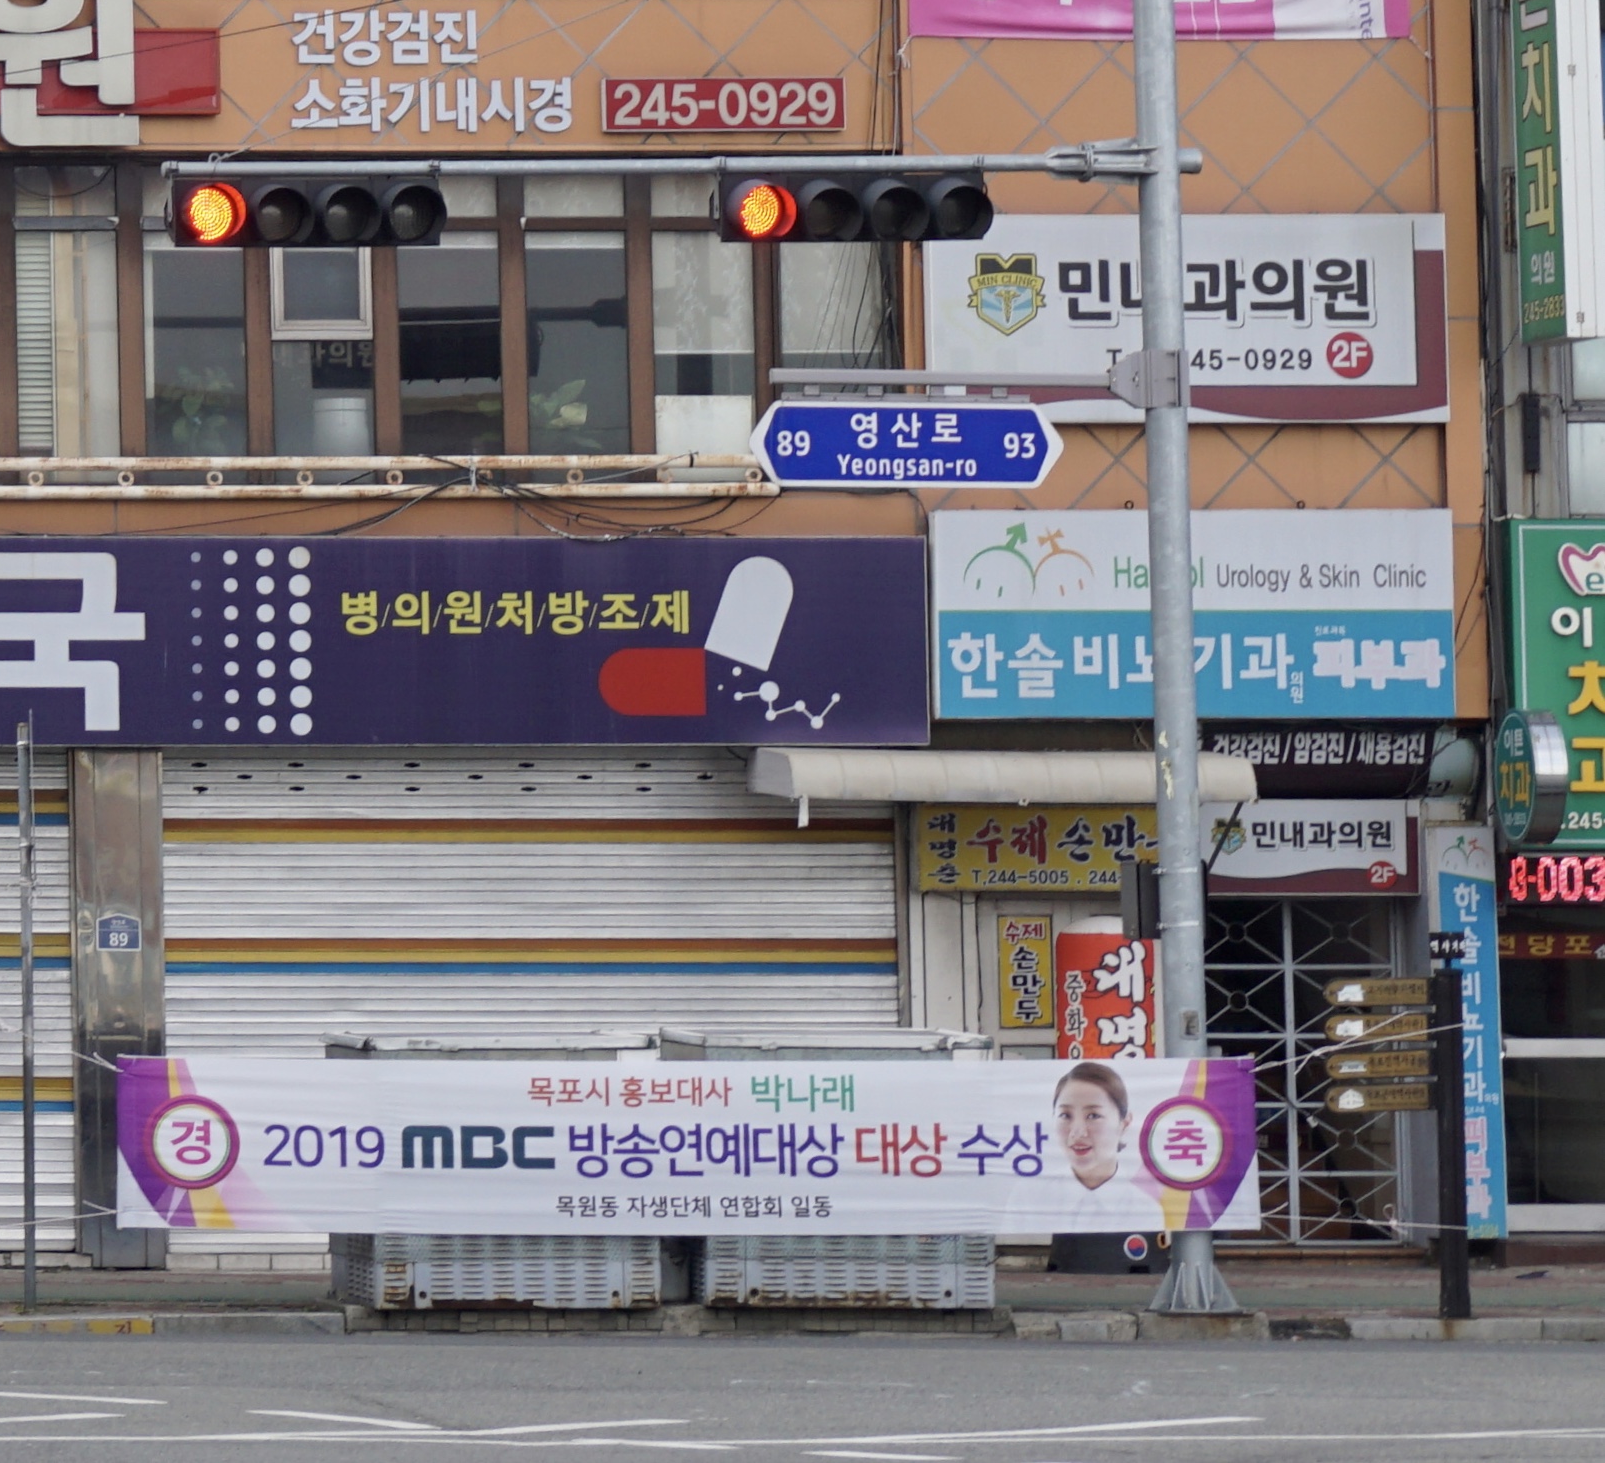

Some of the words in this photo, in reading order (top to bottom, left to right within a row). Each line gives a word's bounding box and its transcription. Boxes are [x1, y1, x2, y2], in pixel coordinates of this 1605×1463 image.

[292, 9, 479, 66] 건강검진
[291, 75, 574, 133] 소화기내시경
[612, 81, 837, 127] 245-0929
[1530, 249, 1556, 285] 의원
[1332, 339, 1368, 370] 2F
[850, 411, 963, 450] 영산로
[776, 430, 811, 457] 89
[837, 453, 978, 480] Yeongsan-ro
[1002, 432, 1037, 459] 93
[1114, 555, 1204, 589] Hal
[1217, 563, 1291, 593] Urology
[1299, 565, 1313, 590] &
[1318, 563, 1361, 589] Skin
[1373, 563, 1427, 589] Clinic
[966, 814, 1048, 865] 수제
[1057, 814, 1160, 862] 손만
[1252, 820, 1393, 850] 민내과의원
[1369, 862, 1395, 886] 2F
[109, 932, 129, 947] 89
[1006, 921, 1043, 945] 수제
[526, 1076, 611, 1107] 목포시
[619, 1075, 733, 1108] 홍보대사
[751, 1074, 856, 1114] 박나래
[171, 1119, 213, 1166] 경
[263, 1124, 385, 1168] 2019
[569, 1122, 845, 1179] 방송연예대상
[855, 1122, 948, 1178] 대상
[957, 1122, 1049, 1178] 수상
[1163, 1119, 1207, 1167] 축
[556, 1194, 619, 1219] 목원동
[627, 1194, 712, 1219] 자생단체
[719, 1194, 784, 1219] 연합회
[791, 1194, 833, 1219] 일동
